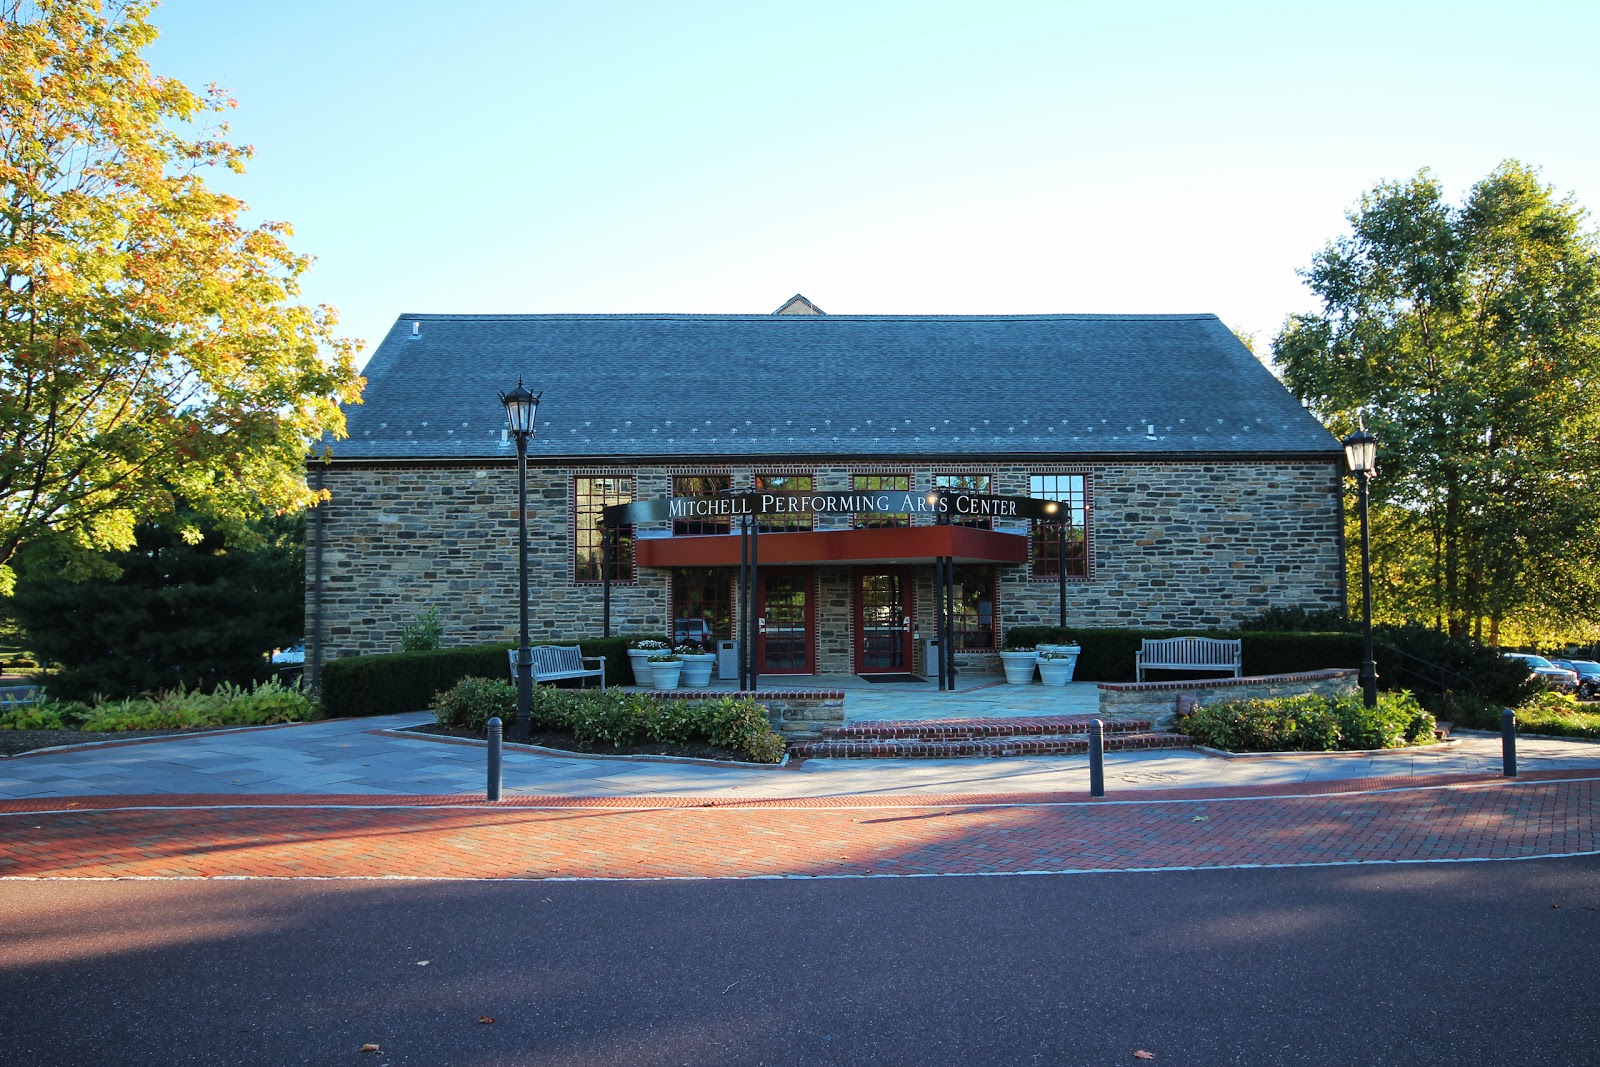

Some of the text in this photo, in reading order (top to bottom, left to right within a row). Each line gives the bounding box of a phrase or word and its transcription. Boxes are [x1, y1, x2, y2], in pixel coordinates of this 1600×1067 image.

[668, 494, 1017, 518] MITCHELL PERFORMING ARTS CENTER
